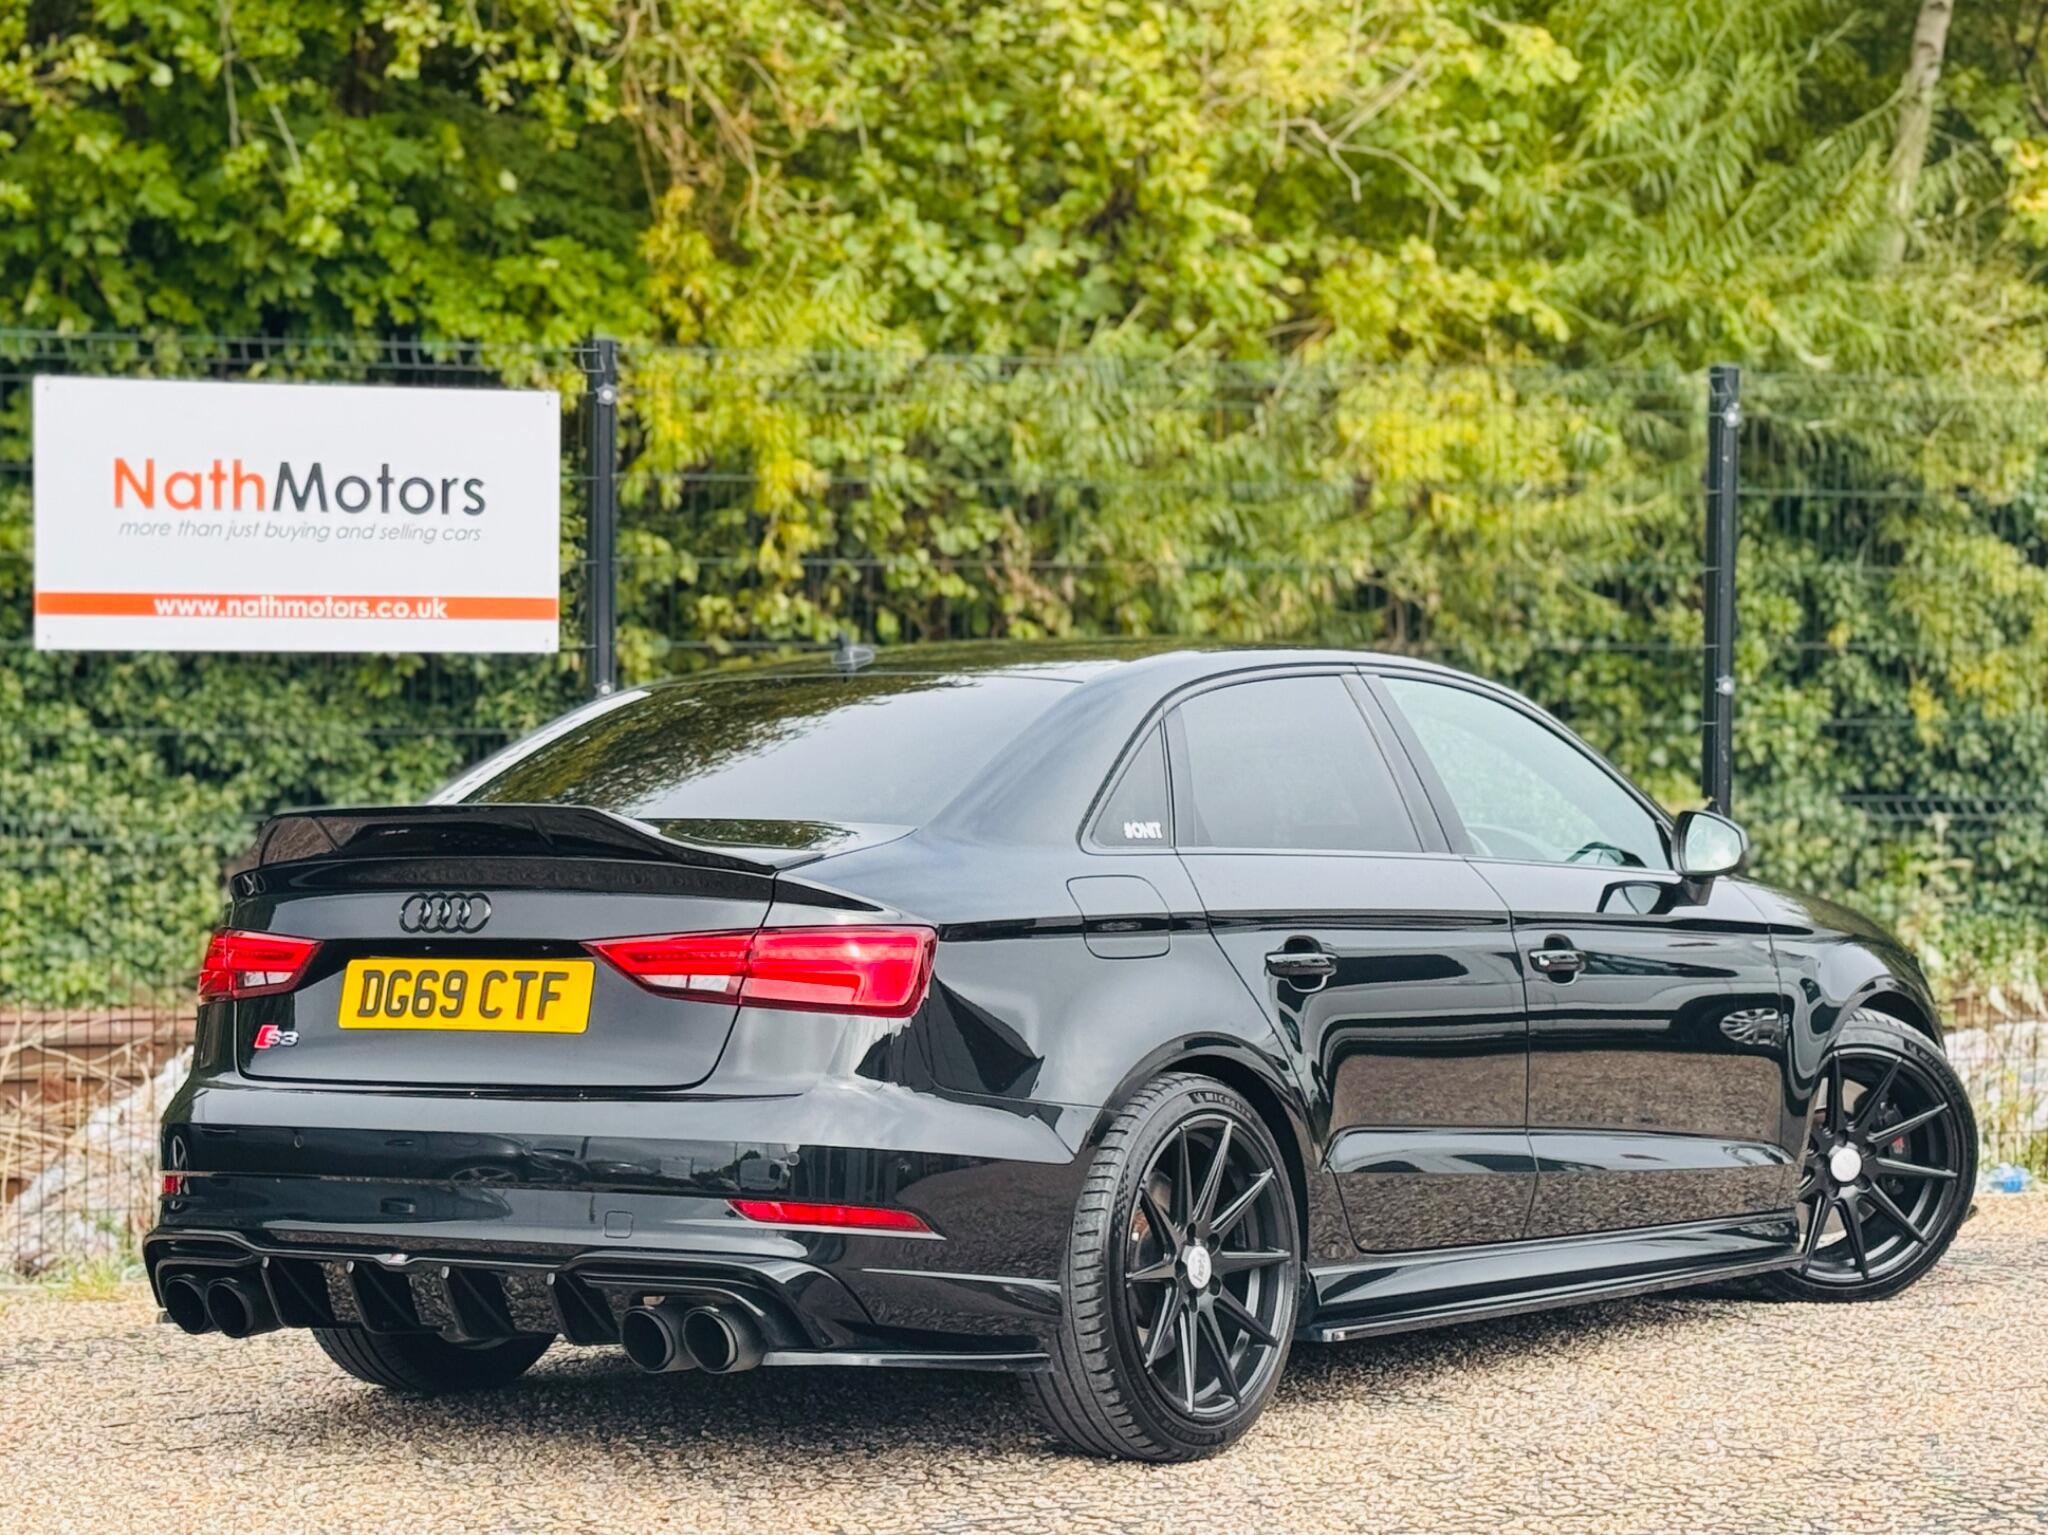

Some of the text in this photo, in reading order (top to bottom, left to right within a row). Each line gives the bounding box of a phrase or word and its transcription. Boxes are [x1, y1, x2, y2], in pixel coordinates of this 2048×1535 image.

[113, 457, 486, 516] NathMotors
[118, 519, 482, 544] more than just buying and selling cars
[154, 596, 448, 619] www.nathmotors.co.uk
[357, 969, 569, 1020] DG69 CTF
[262, 1029, 300, 1047] S3
